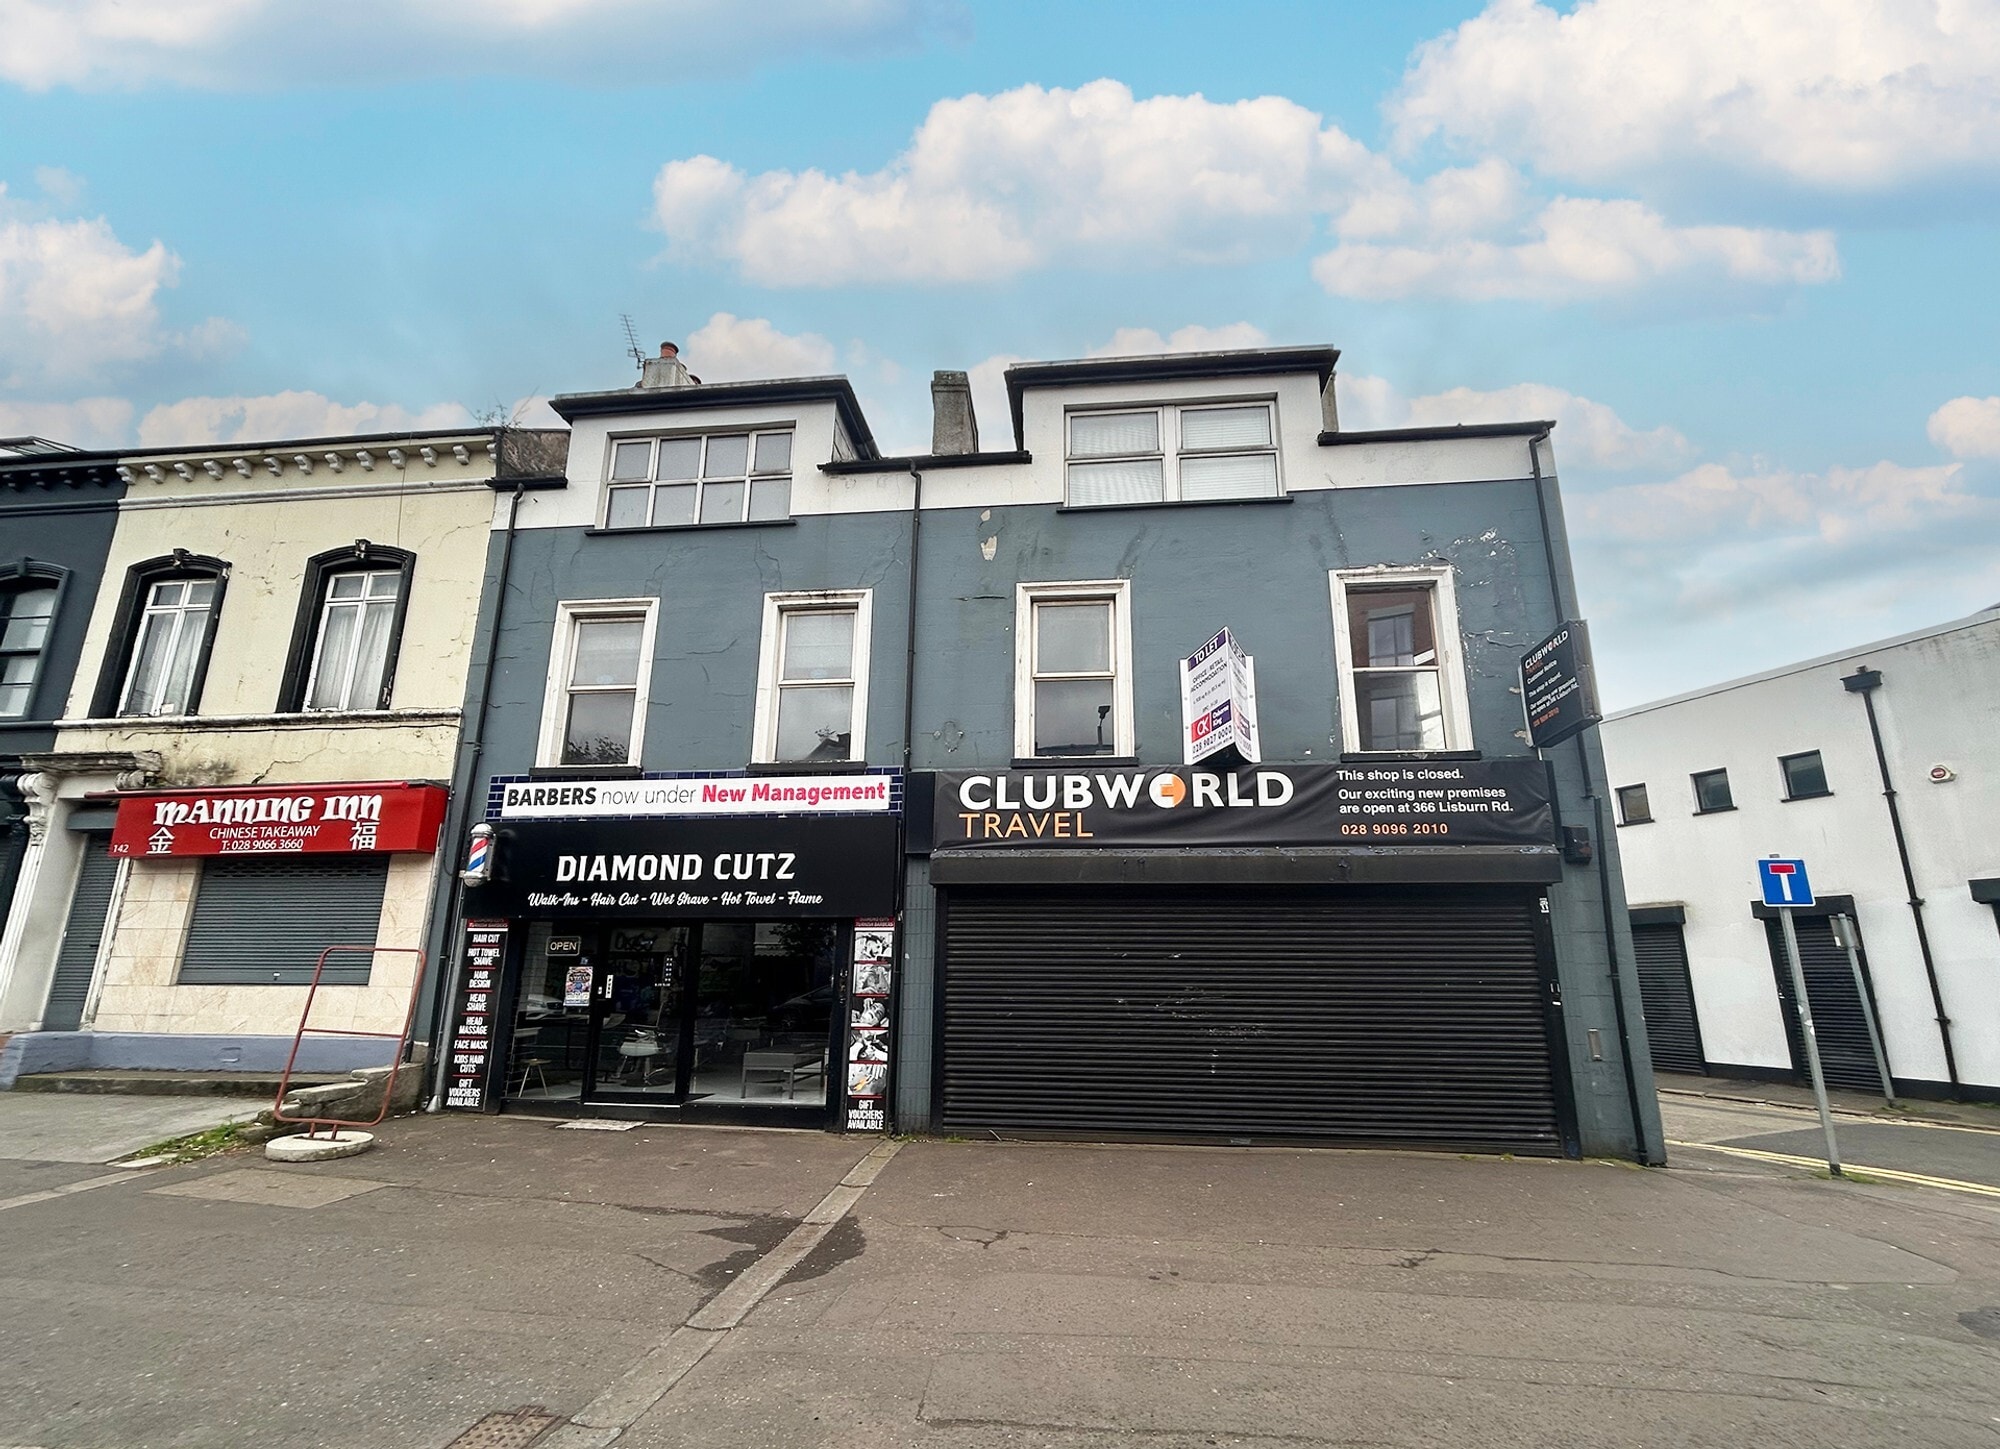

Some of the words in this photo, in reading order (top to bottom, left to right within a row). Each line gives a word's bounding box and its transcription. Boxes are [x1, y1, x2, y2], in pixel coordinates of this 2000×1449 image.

[1194, 651, 1204, 665] TO
[1205, 637, 1219, 658] LET
[1525, 630, 1568, 669] CLUBWORLD
[1336, 769, 1364, 781] This
[1367, 769, 1400, 782] shop
[1402, 769, 1414, 780] is
[1417, 768, 1464, 780] closed.
[507, 787, 597, 807] BARBERS
[601, 790, 639, 805] now
[644, 784, 697, 804] under
[702, 784, 746, 803] New
[751, 782, 886, 806] Management
[958, 771, 1295, 811] CLUBWORLD
[1338, 788, 1362, 800] Our
[1364, 788, 1415, 801] exciting
[1417, 789, 1444, 799] new
[1447, 787, 1506, 800] premises
[1339, 804, 1360, 814] are
[1362, 804, 1395, 815] open
[1397, 802, 1410, 813] at
[1413, 802, 1436, 813] 366
[1438, 801, 1488, 813] Lisburn
[1491, 801, 1514, 812] Rd.
[958, 811, 1094, 839] TRAVEL
[1341, 824, 1368, 835] 028
[1373, 823, 1407, 835] 9096
[1413, 823, 1448, 834] 2010
[209, 827, 258, 840] CHINESE
[259, 825, 321, 838] TAKEAWAY
[349, 821, 380, 851] 福
[146, 826, 175, 855] 金
[221, 840, 230, 850] T:
[231, 840, 250, 850] 028
[252, 839, 278, 849] 9066
[278, 838, 304, 849] 3660
[112, 844, 129, 853] 142
[556, 854, 703, 881] DIAMOND
[713, 852, 796, 880] CUTZ
[527, 892, 580, 907] Walk-Ins
[590, 892, 616, 906] Hair
[618, 892, 639, 906] Cut
[649, 892, 675, 906] Wet
[677, 891, 710, 906] Shave
[720, 891, 743, 906] Hot
[744, 890, 777, 906] Towel
[787, 890, 824, 905] Flame
[472, 933, 488, 943] HAIR
[488, 934, 500, 943] CUT
[549, 941, 577, 951] OPEN
[467, 948, 481, 957] HOT
[481, 948, 500, 957] TOWEL
[473, 956, 493, 966] SHAVE
[473, 970, 489, 979] HAIR
[468, 979, 491, 988] DESIGN
[469, 993, 487, 1002] HEAD
[466, 1002, 487, 1012] SHAVE
[466, 1016, 483, 1026] HEAD
[458, 1025, 488, 1035] MASSAGE
[453, 1040, 470, 1049] FACE
[470, 1040, 488, 1050] MASK
[453, 1054, 469, 1064] KIDS
[469, 1055, 484, 1064] HAIR
[459, 1064, 477, 1073] CUTS
[458, 1078, 473, 1088] GIFT
[448, 1087, 481, 1097] VOUCHERS
[446, 1097, 480, 1107] AVAILABLE
[858, 1099, 874, 1110] GIFT
[848, 1109, 884, 1120] VOUCHERS
[847, 1119, 884, 1130] AVAILABLE
